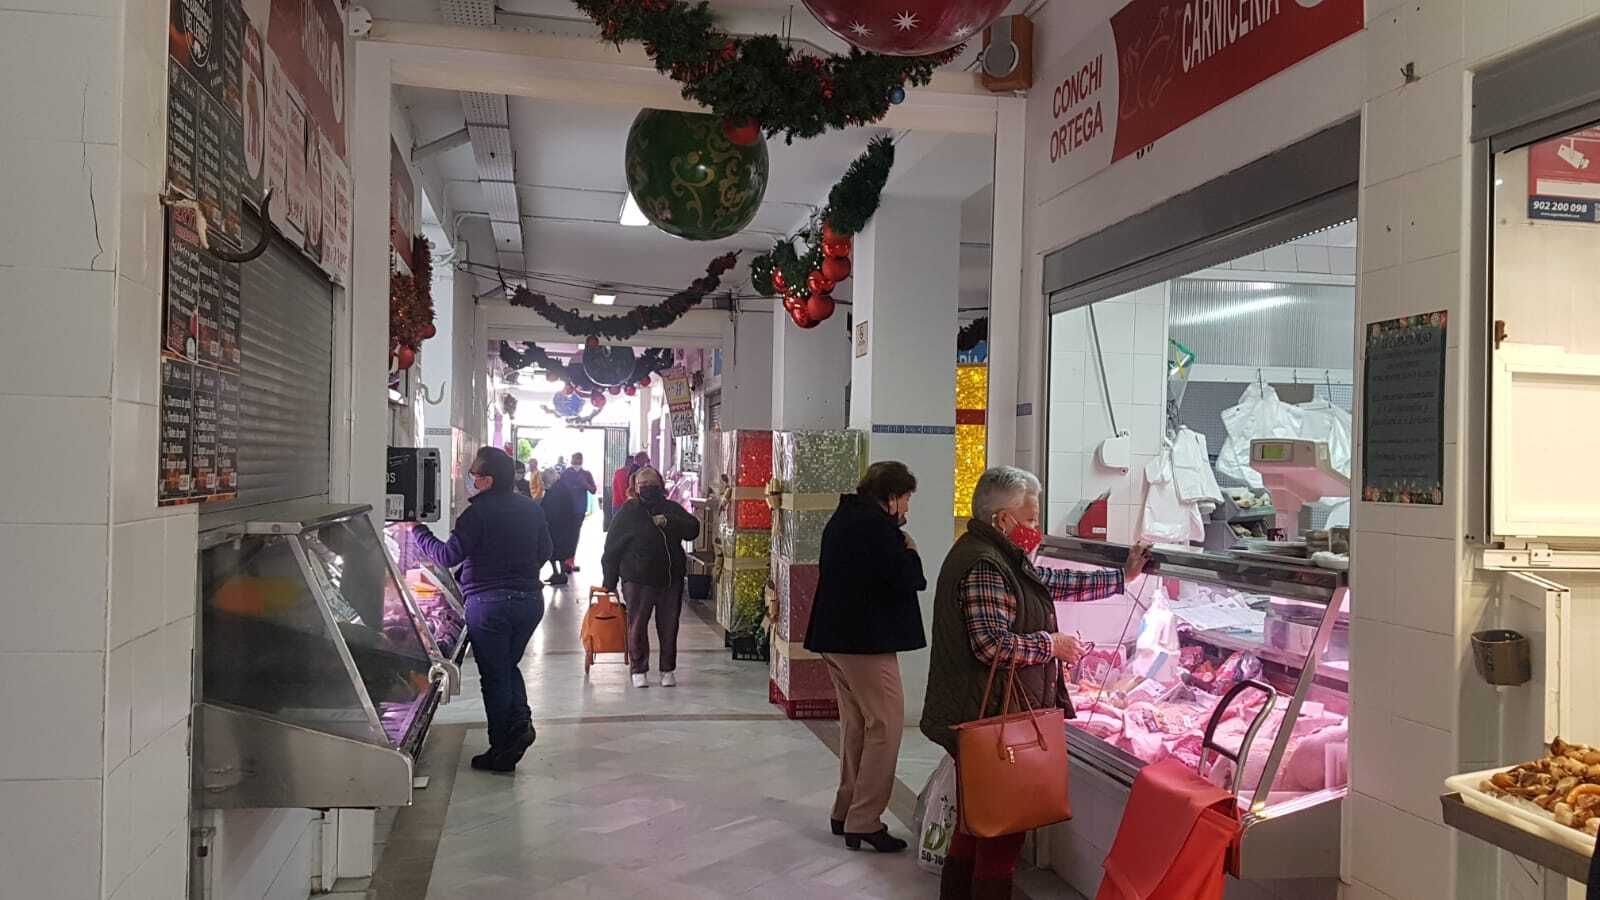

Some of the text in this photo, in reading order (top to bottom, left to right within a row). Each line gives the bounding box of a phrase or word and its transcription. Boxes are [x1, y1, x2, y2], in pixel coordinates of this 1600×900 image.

[1182, 0, 1280, 73] CARNICE
[1053, 54, 1103, 119] CONCHI
[1050, 101, 1103, 163] ORTEGA
[1533, 200, 1588, 213] 902 200 098
